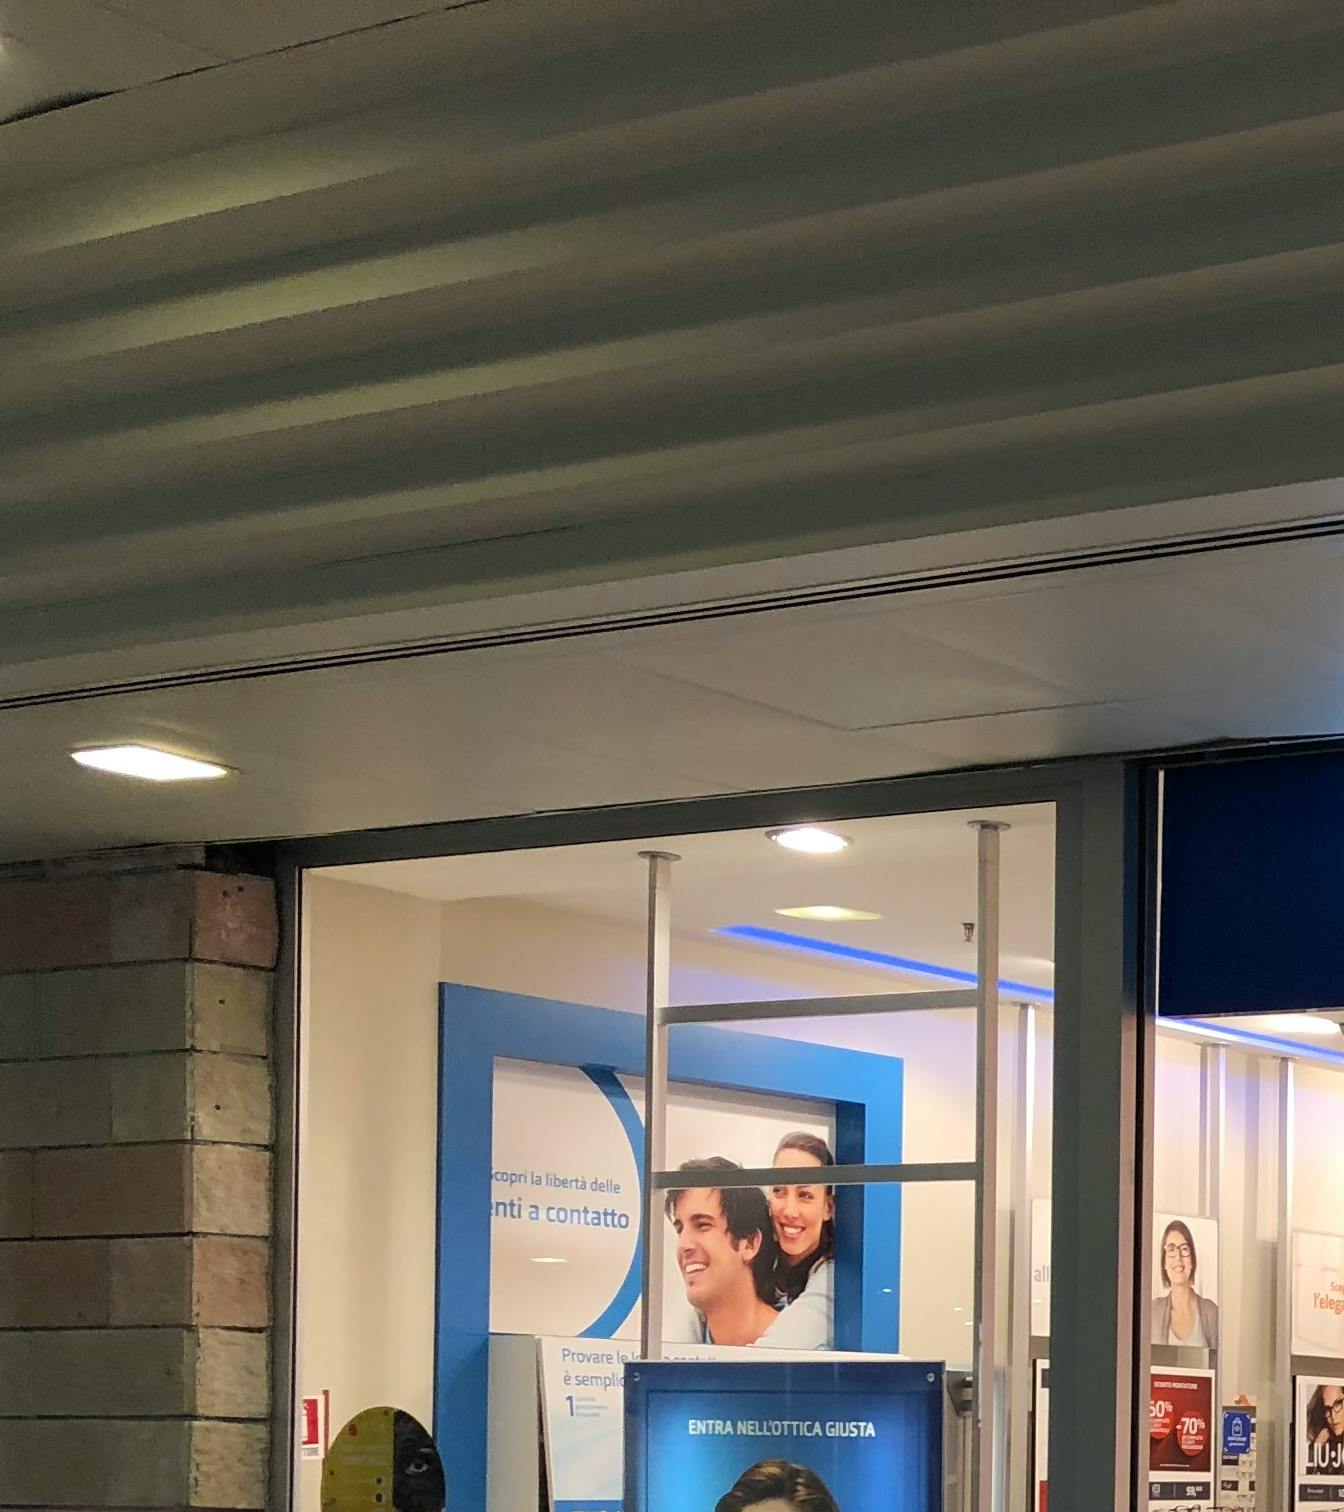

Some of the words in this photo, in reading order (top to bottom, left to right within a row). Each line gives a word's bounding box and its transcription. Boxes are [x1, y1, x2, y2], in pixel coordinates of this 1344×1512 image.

[491, 1170, 528, 1188] copri
[531, 1171, 542, 1187] la
[545, 1172, 588, 1191] libertà
[590, 1177, 621, 1195] delle
[491, 1197, 523, 1220] nti
[528, 1204, 540, 1222] a
[545, 1205, 631, 1230] contatto
[1034, 1266, 1050, 1283] all
[561, 1347, 615, 1364] Provare
[563, 1371, 571, 1386] è
[574, 1372, 625, 1391] semplic
[565, 1395, 575, 1417] 1
[1149, 1400, 1174, 1418] 50%
[688, 1419, 734, 1436] ENTRA
[736, 1420, 823, 1437] NELL'OTTICA
[825, 1421, 877, 1438] GIUSTA
